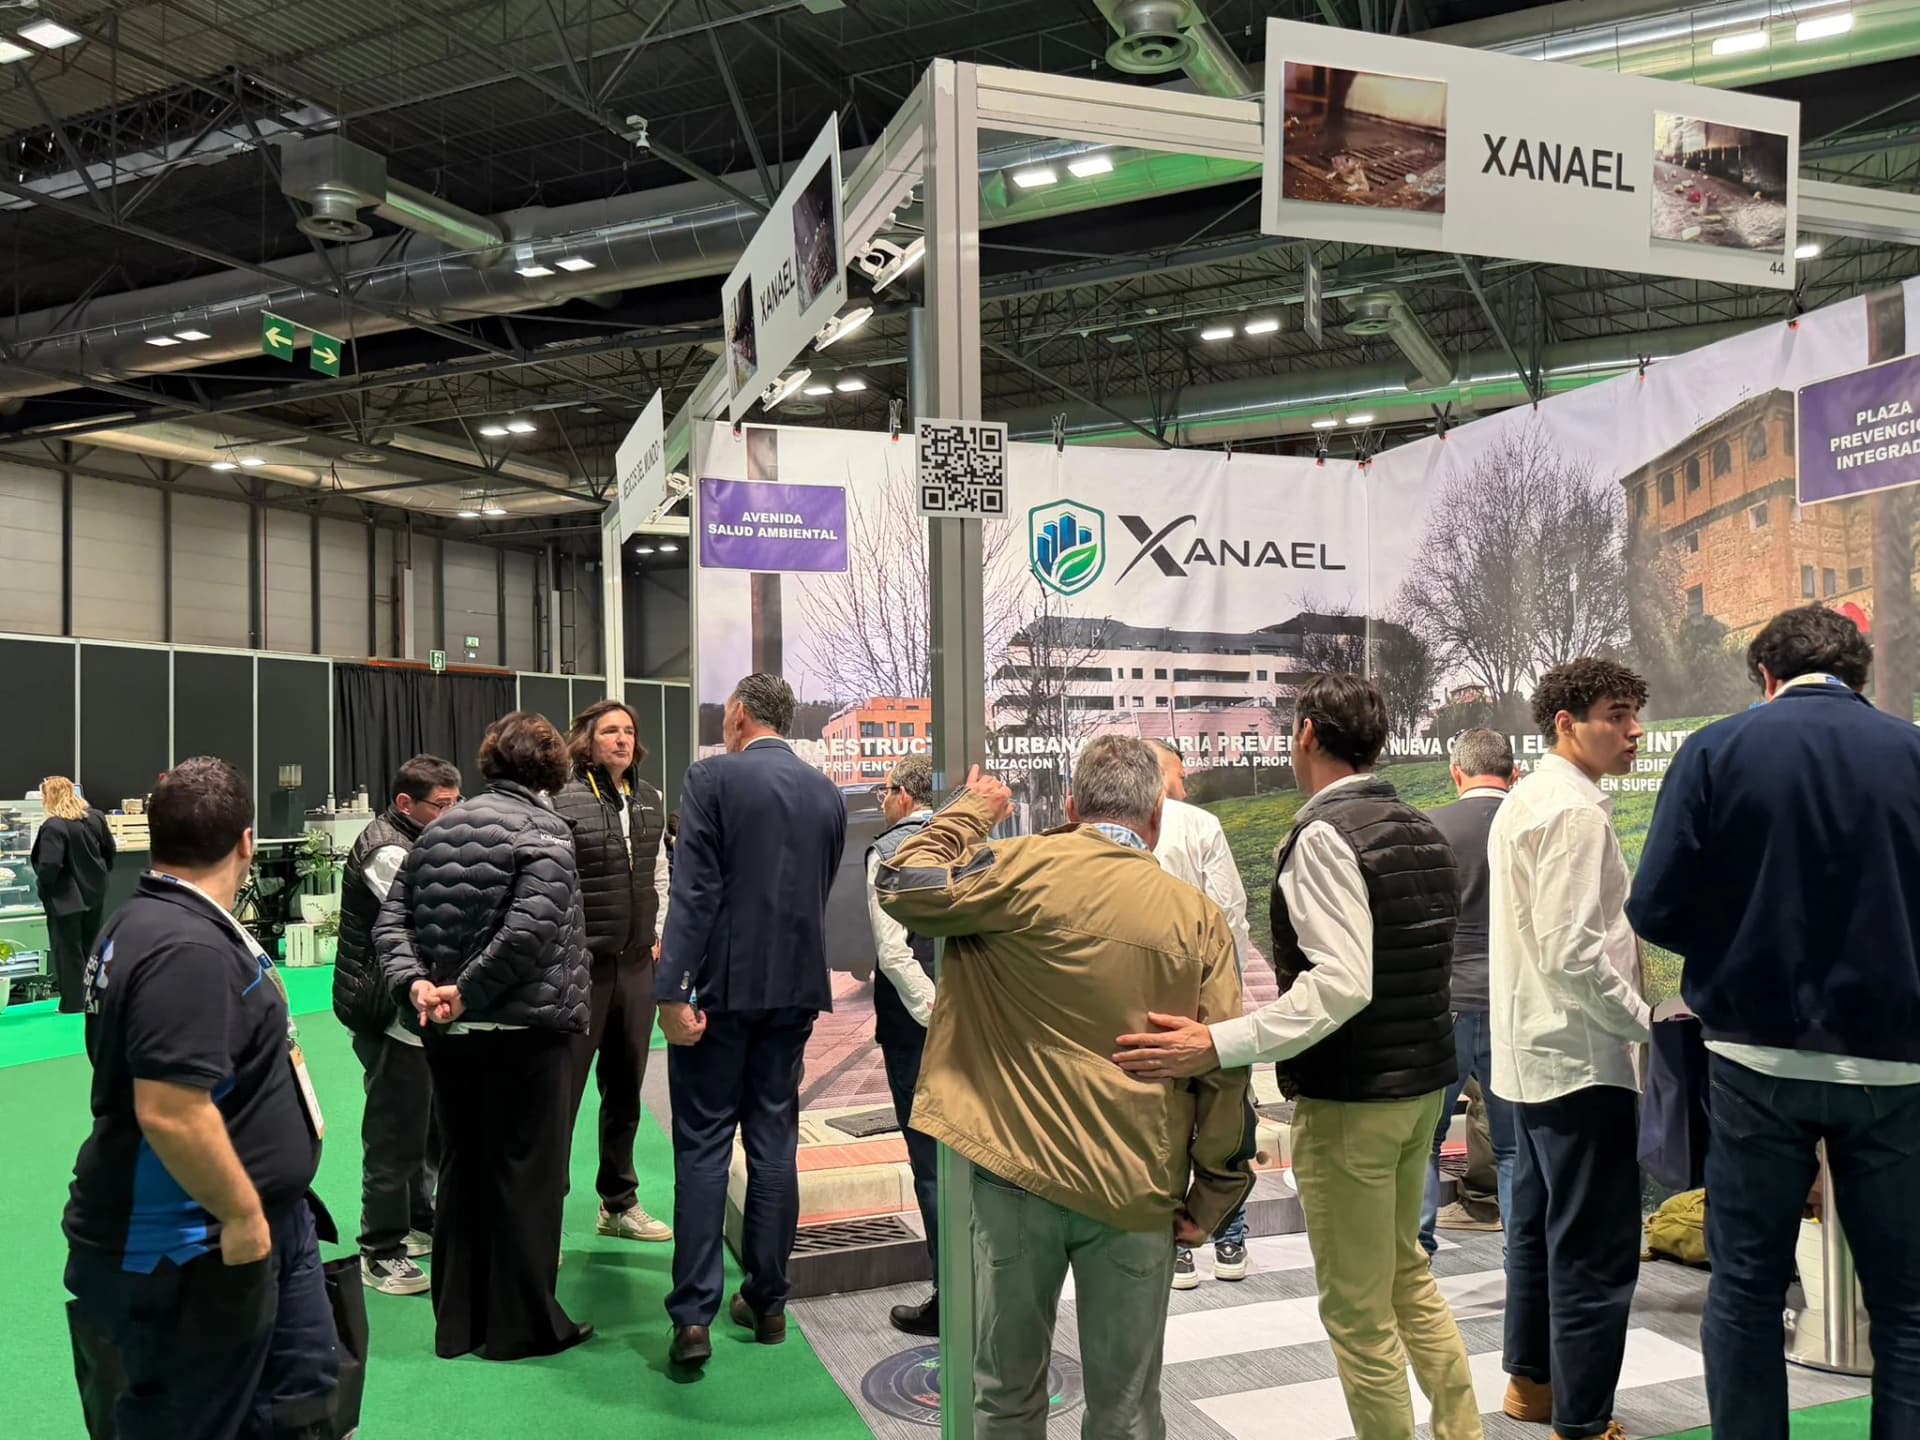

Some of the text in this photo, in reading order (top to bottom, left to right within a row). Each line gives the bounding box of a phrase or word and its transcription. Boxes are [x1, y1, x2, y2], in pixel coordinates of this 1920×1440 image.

[1481, 133, 1636, 193] XANAEL
[1769, 261, 1785, 275] 44
[760, 256, 796, 327] XANAEL
[1856, 400, 1913, 427] PLAZA
[742, 511, 803, 525] AVENIDA
[708, 523, 839, 540] SALUD AMBIENTAL
[1114, 514, 1347, 586] XANAEL
[1390, 737, 1442, 755] NUEVA
[1213, 757, 1229, 767] EN
[1233, 757, 1250, 767] LA
[1602, 780, 1618, 792] EN
